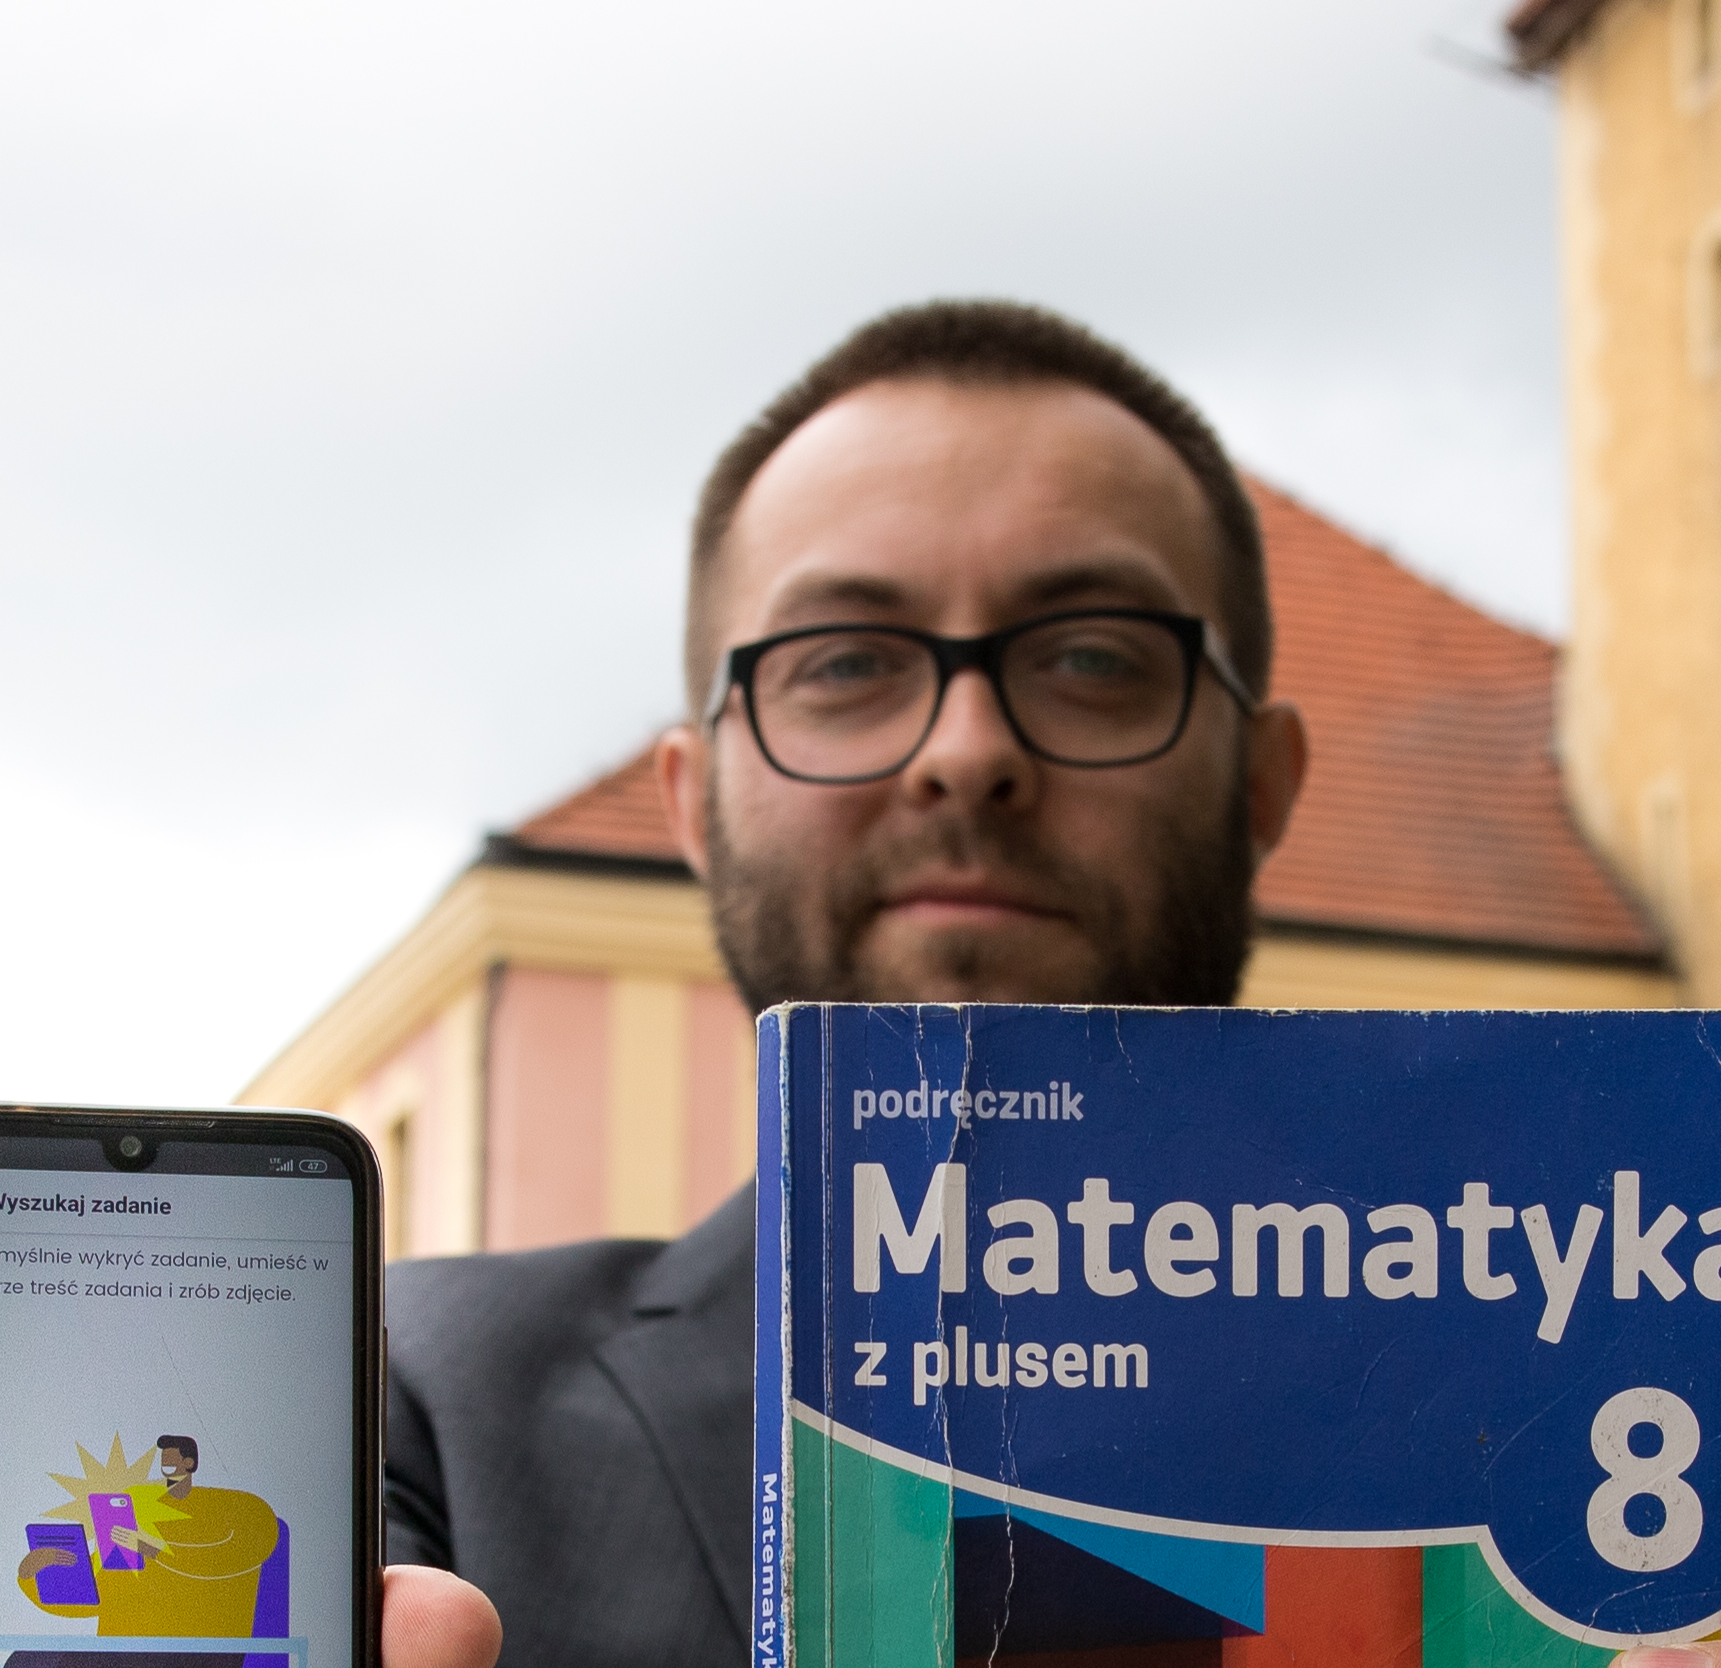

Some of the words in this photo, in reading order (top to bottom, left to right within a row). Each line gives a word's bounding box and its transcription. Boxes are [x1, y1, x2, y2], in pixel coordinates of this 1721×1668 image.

[852, 1082, 1085, 1129] podręcznik
[307, 1162, 320, 1171] 47
[91, 1195, 172, 1215] zadanie
[78, 1249, 145, 1270] wykryć
[151, 1251, 231, 1271] zadanie,
[237, 1254, 307, 1271] umieść
[312, 1258, 329, 1271] w
[30, 1279, 79, 1296] treść
[84, 1281, 162, 1298] zadania
[168, 1282, 173, 1298] i
[179, 1283, 220, 1299] zrób
[226, 1284, 296, 1304] zdjęcie.
[852, 1339, 887, 1387] z
[913, 1325, 1150, 1407] plusem
[1585, 1386, 1705, 1573] 8
